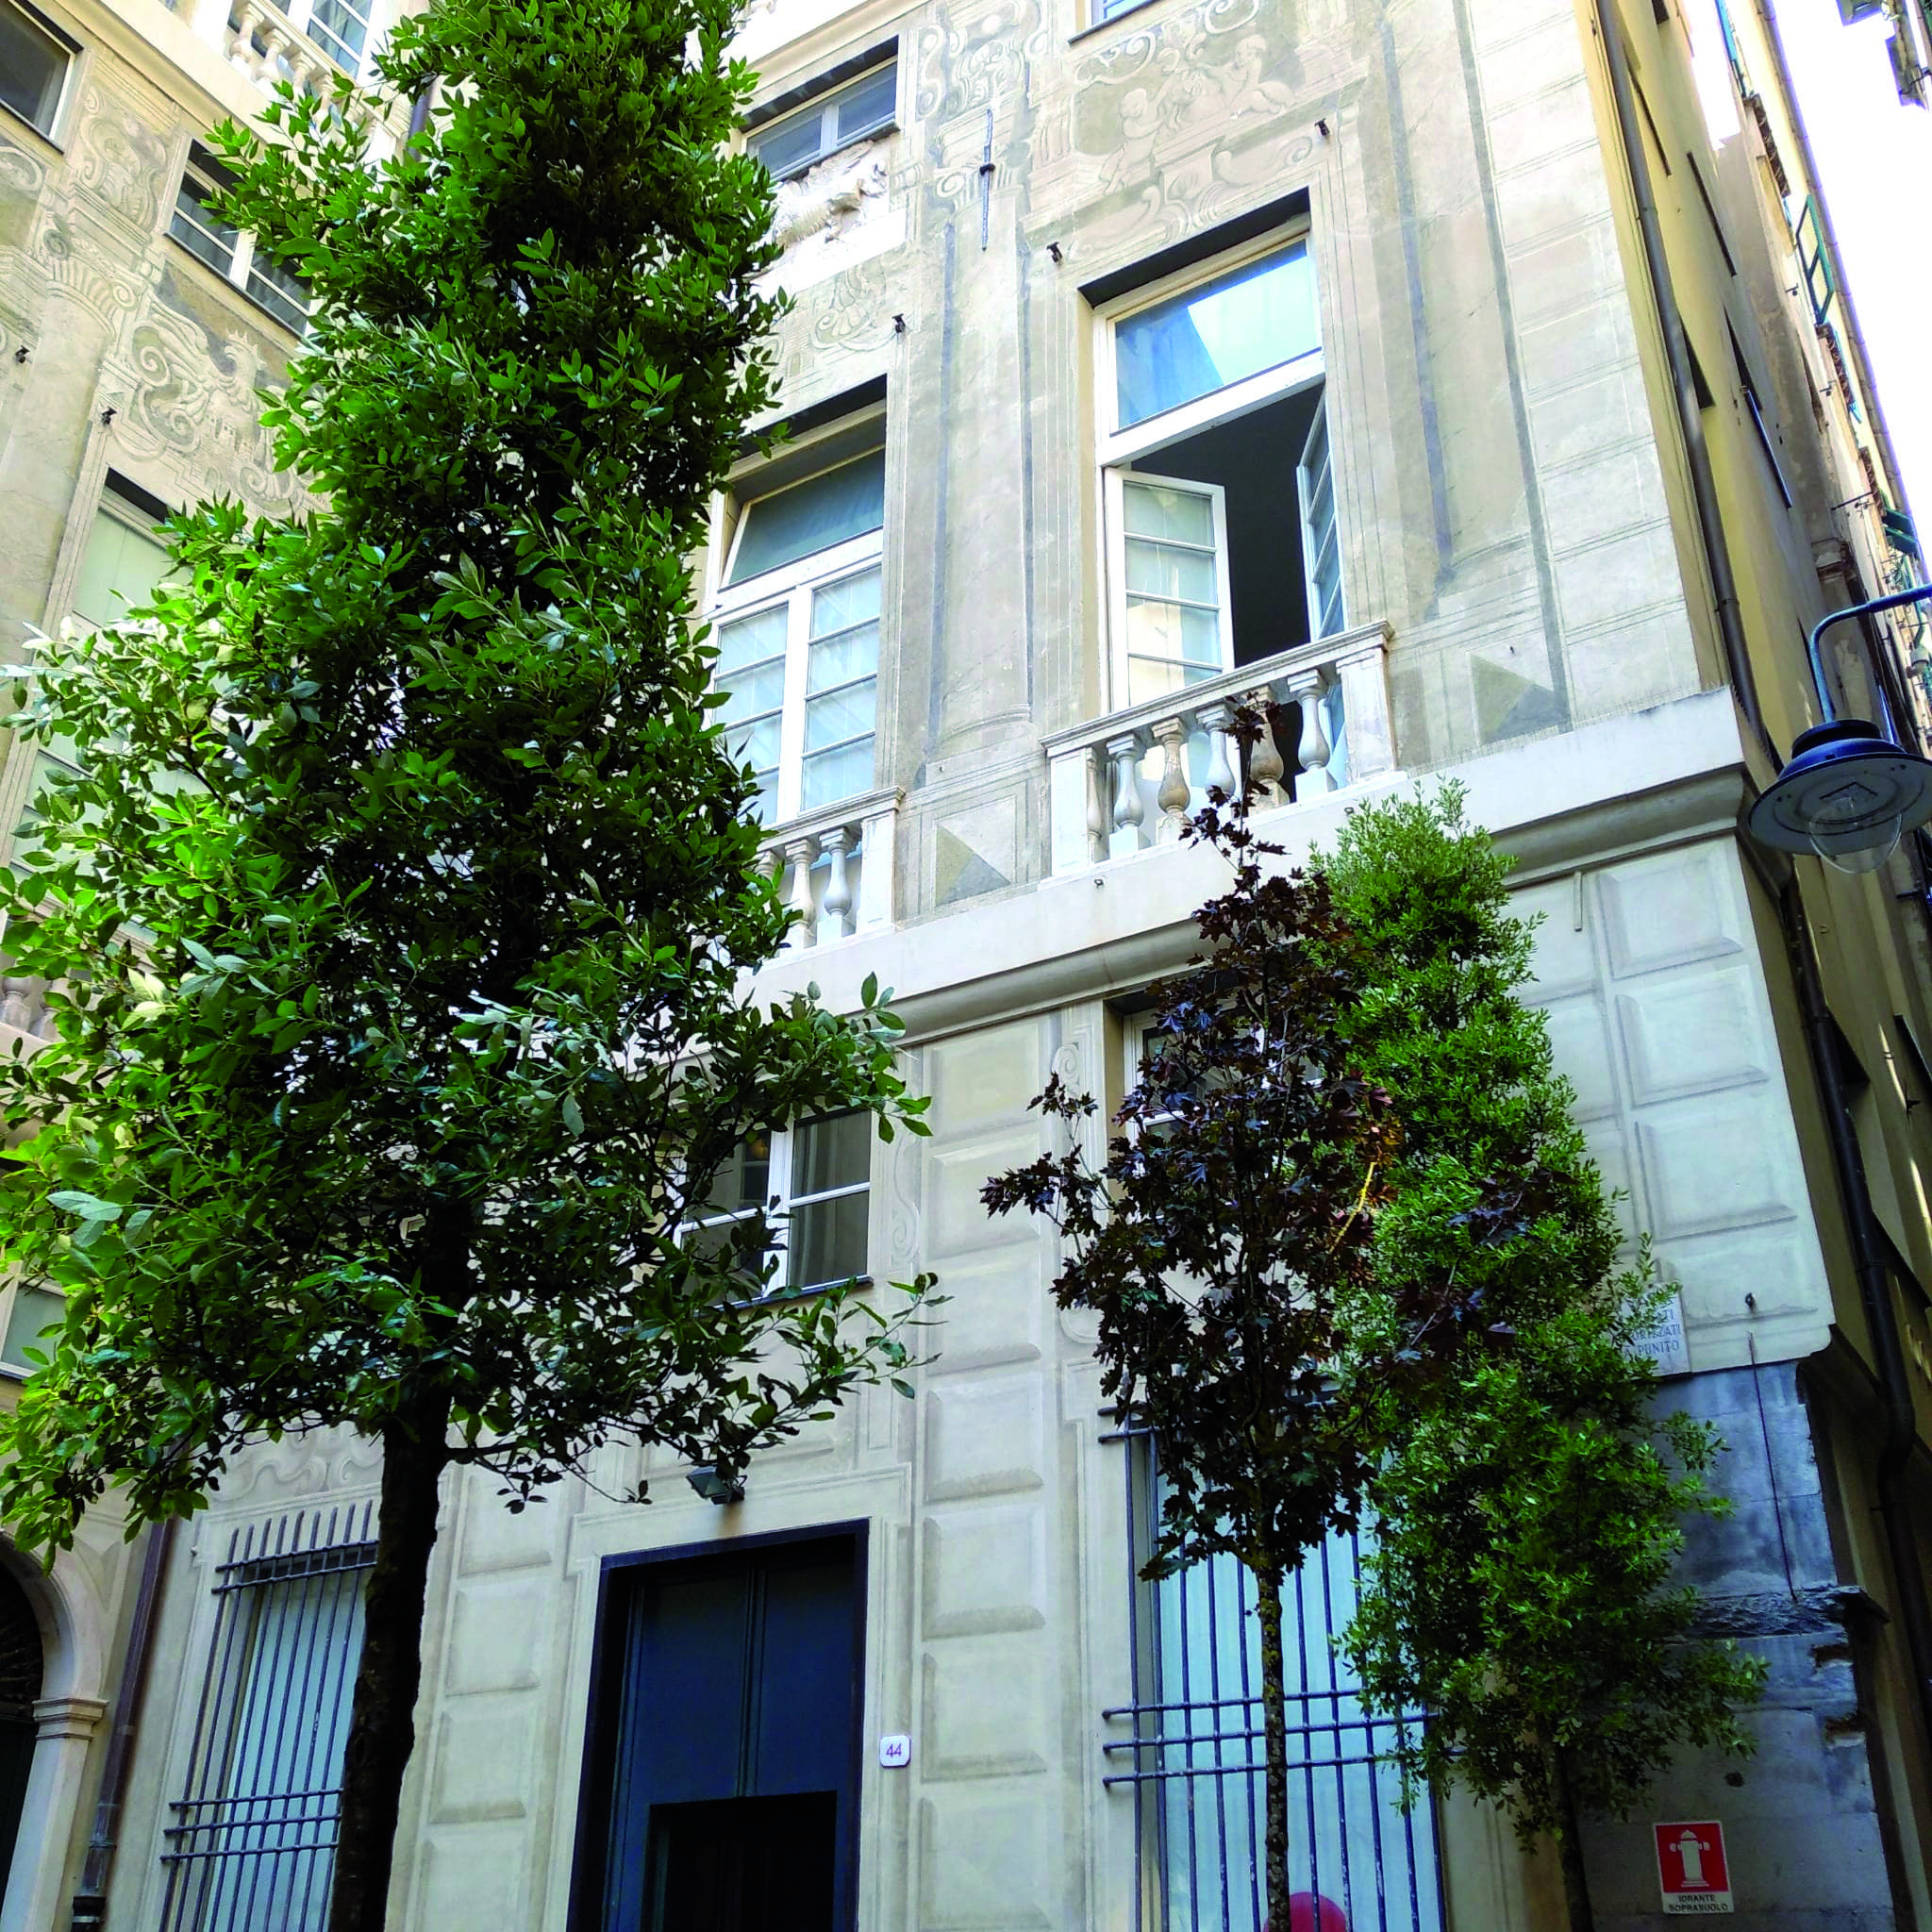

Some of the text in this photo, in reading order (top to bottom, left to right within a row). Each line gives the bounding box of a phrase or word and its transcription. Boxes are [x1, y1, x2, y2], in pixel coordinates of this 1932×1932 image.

[1638, 1340, 1679, 1356] PUNITO
[886, 1743, 902, 1757] 44
[1678, 1894, 1715, 1903] IDRANTE
[1669, 1903, 1728, 1912] SOPRASUOLO
